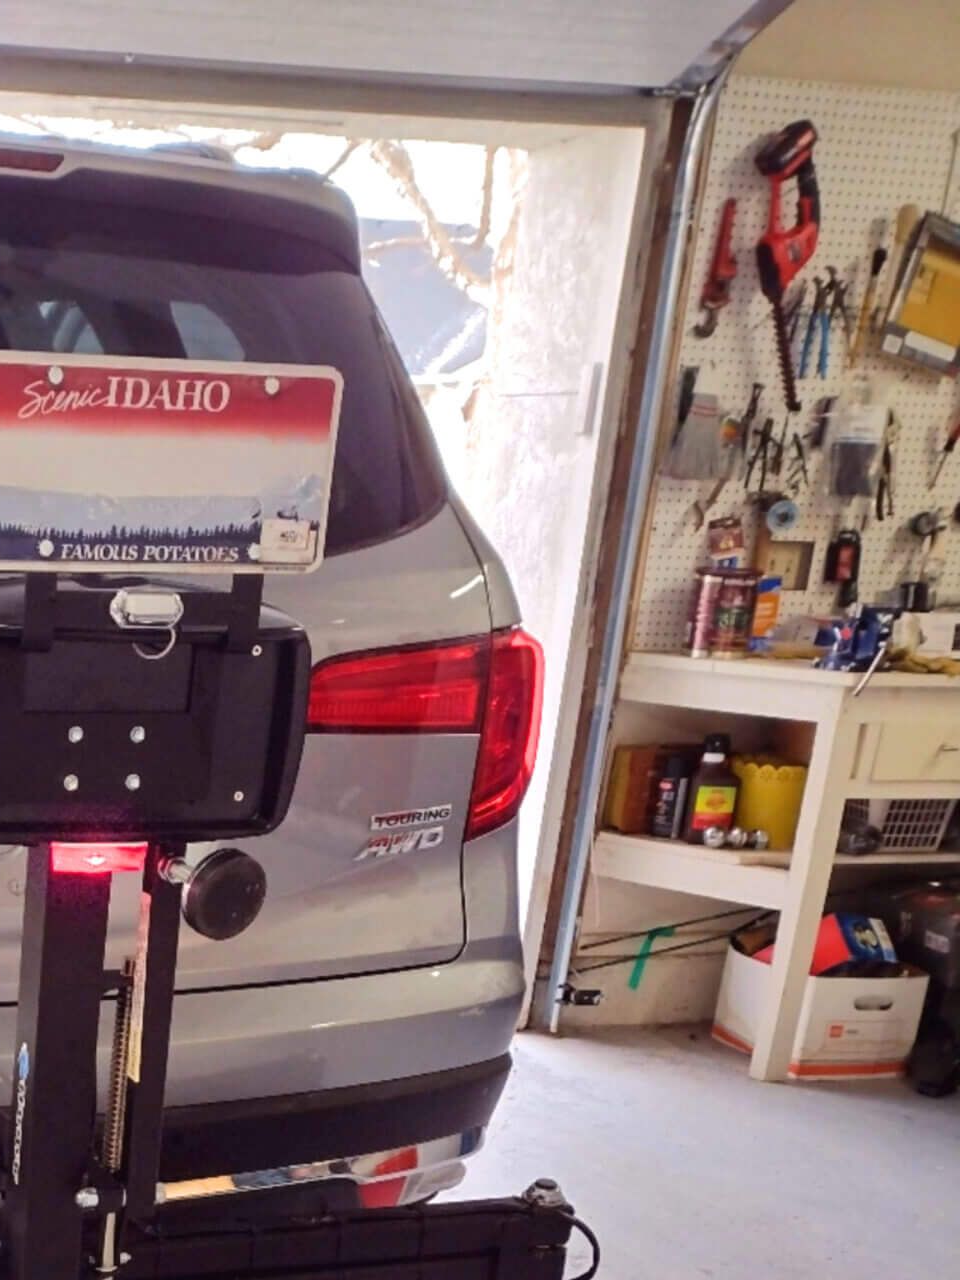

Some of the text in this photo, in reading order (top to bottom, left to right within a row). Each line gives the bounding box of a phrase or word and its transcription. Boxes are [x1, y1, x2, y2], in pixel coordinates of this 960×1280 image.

[17, 375, 231, 419] Scenic IDAHO
[59, 542, 240, 563] FAMOUS POTATOES
[373, 806, 451, 828] TOURING
[353, 826, 444, 861] AWD
